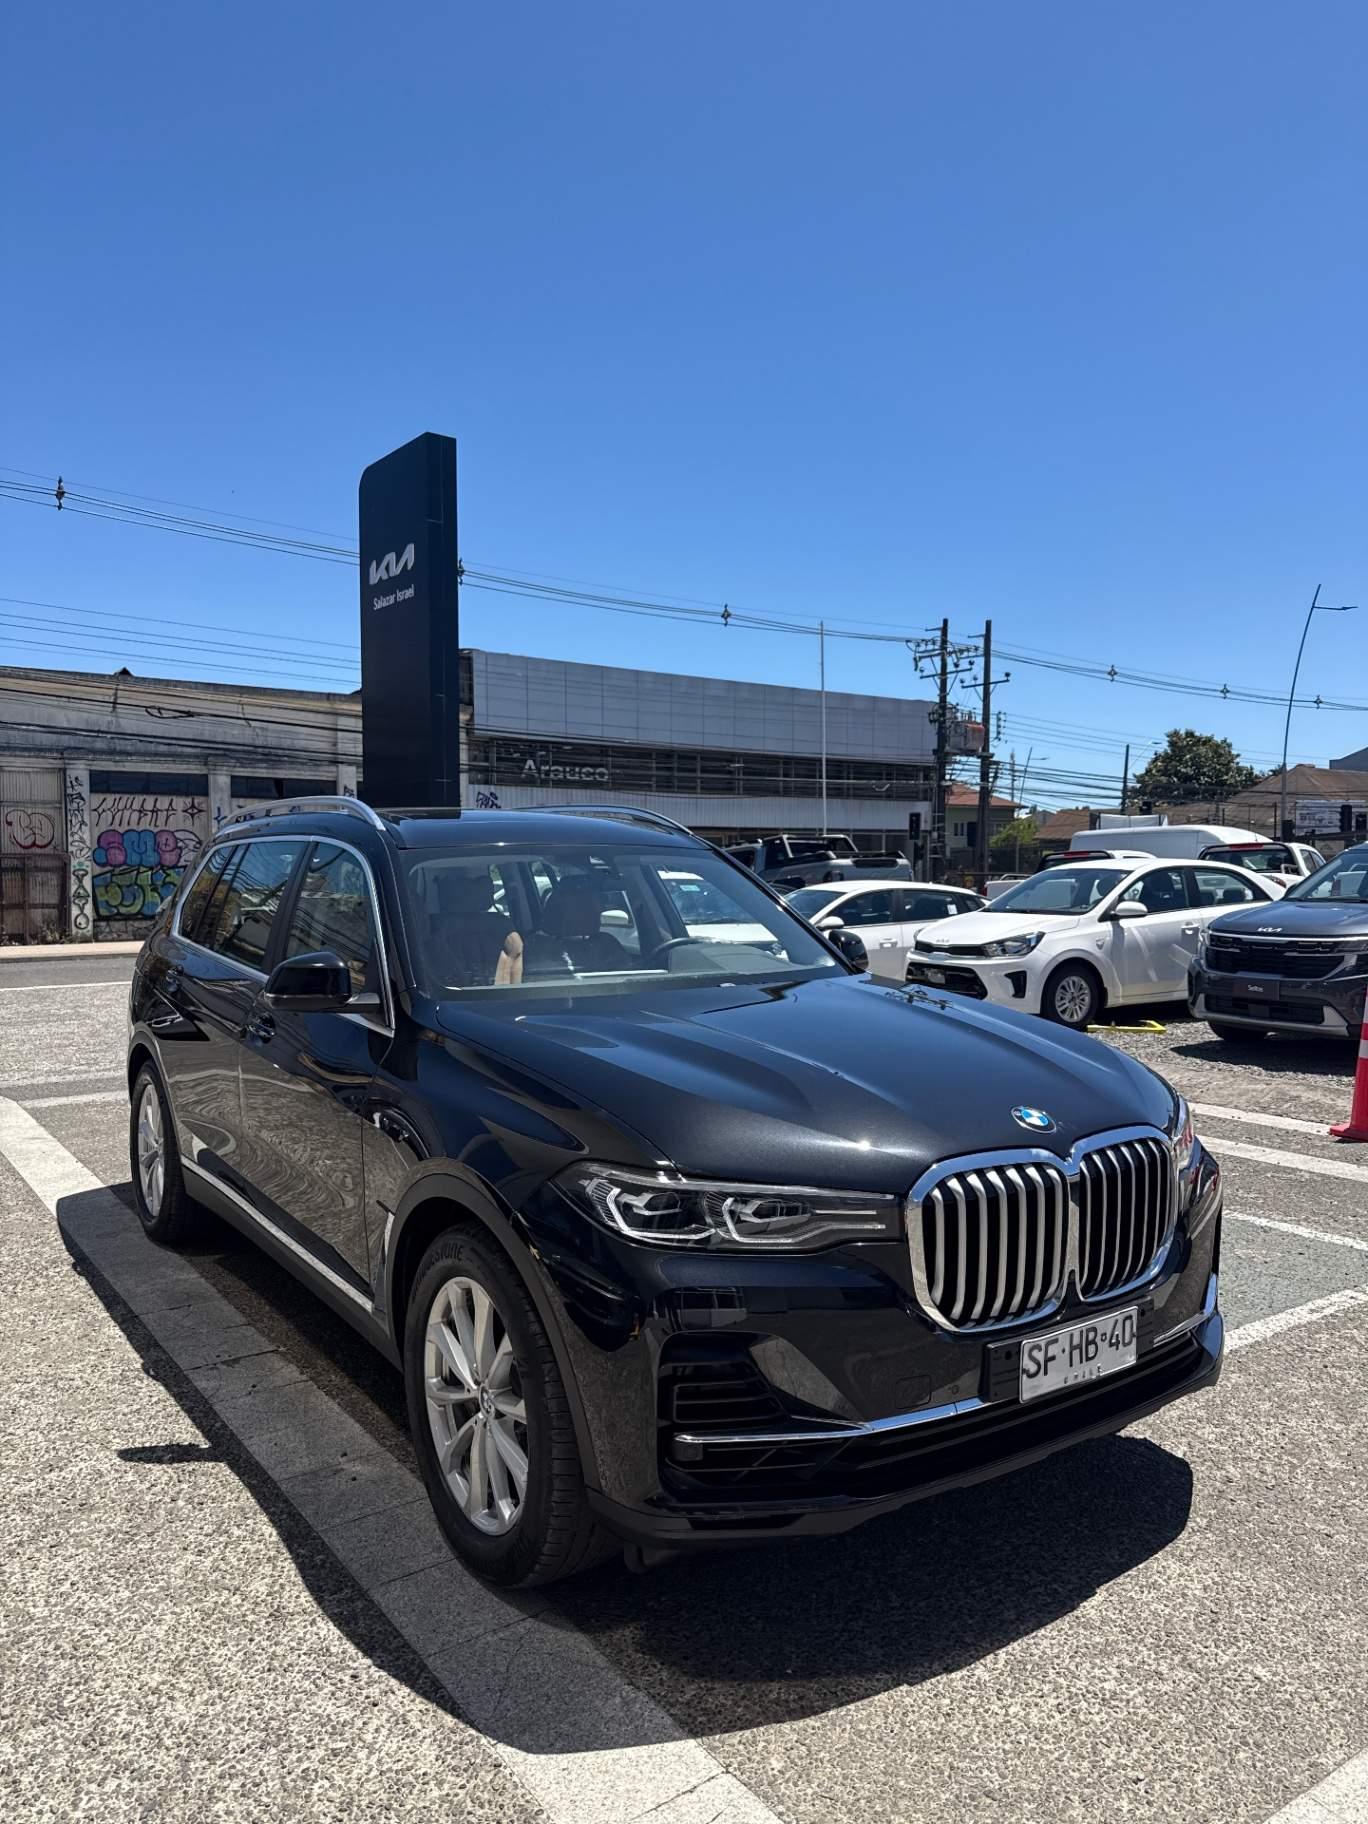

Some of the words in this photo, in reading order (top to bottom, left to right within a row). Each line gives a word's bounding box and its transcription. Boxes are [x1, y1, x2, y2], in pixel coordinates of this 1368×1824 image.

[369, 543, 415, 585] KIA
[373, 594, 396, 610] Salazar
[396, 584, 415, 602] Israel
